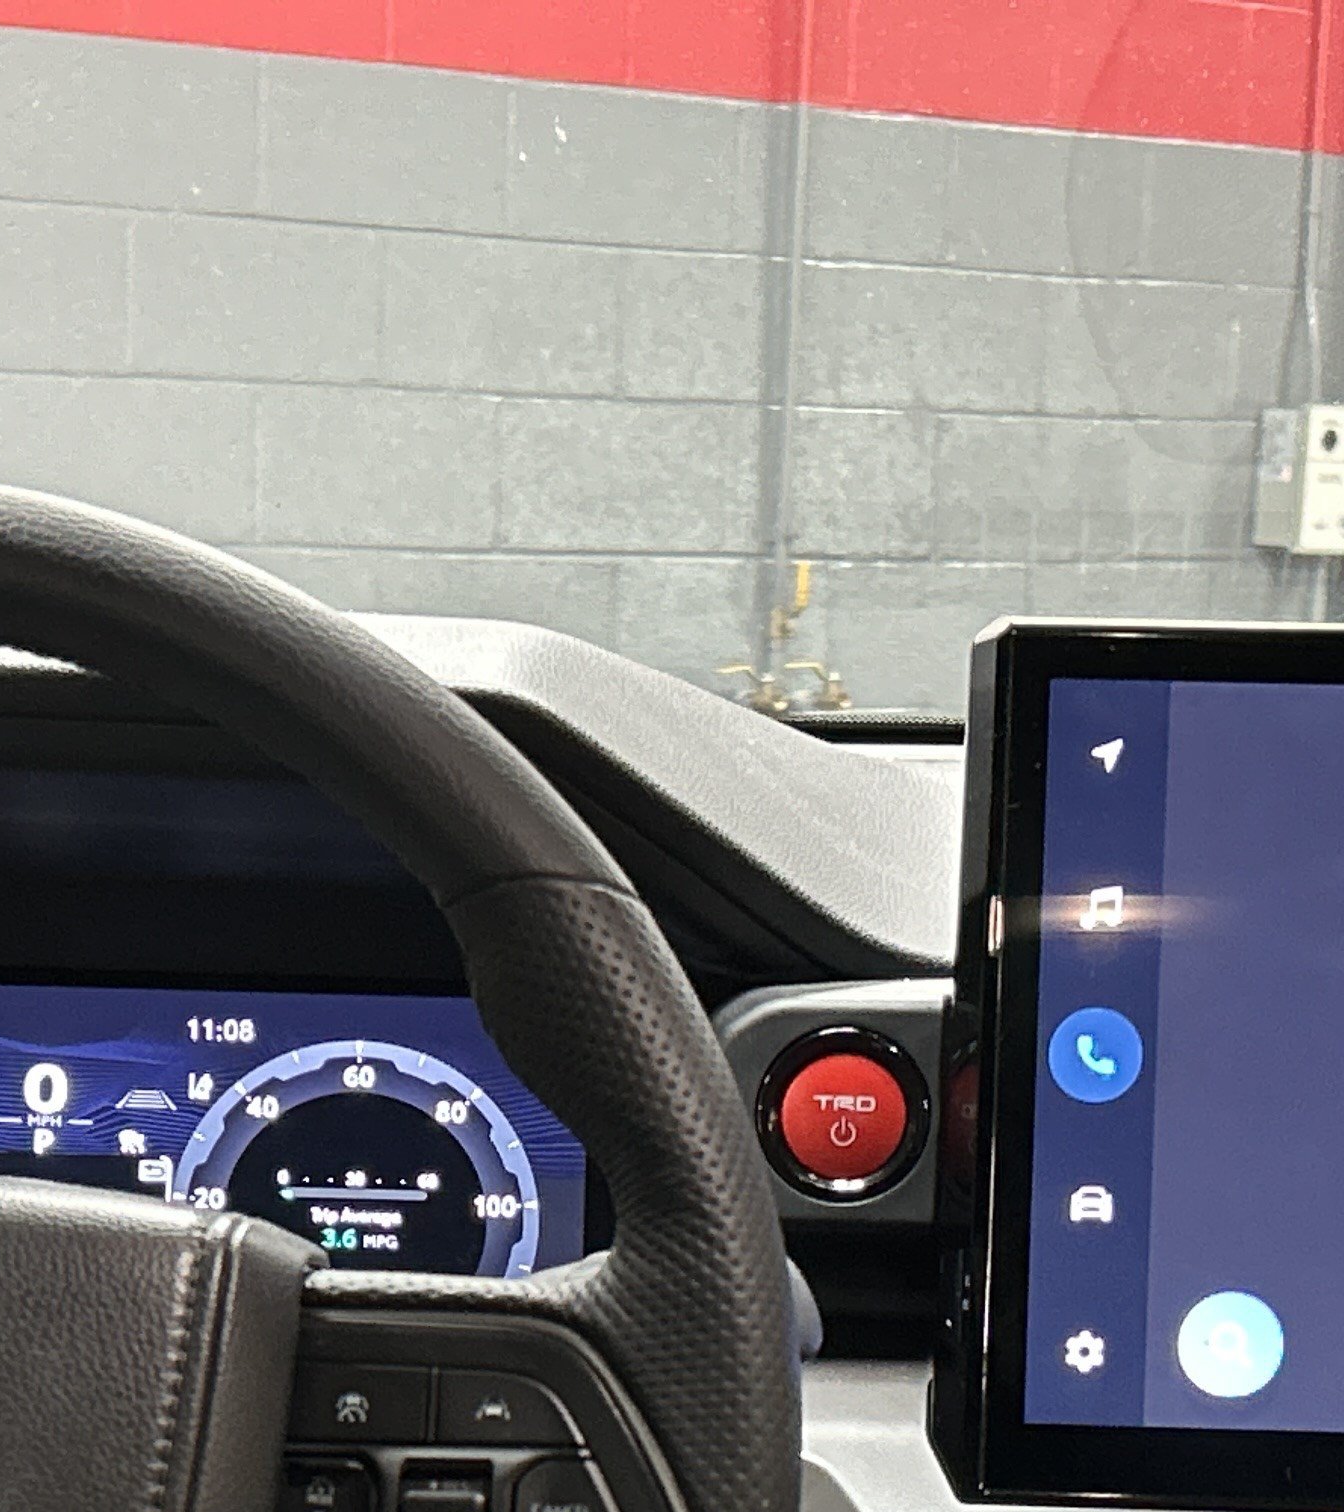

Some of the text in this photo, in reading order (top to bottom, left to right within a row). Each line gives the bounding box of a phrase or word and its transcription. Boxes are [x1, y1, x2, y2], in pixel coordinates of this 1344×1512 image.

[187, 1016, 254, 1042] 11:08
[24, 1062, 68, 1115] 0
[343, 1066, 375, 1089] 60
[247, 1098, 279, 1119] 40
[434, 1100, 467, 1124] 80
[812, 1094, 877, 1113] TRD
[33, 1128, 56, 1155] P
[194, 1188, 225, 1210] 20
[474, 1194, 516, 1218] 100
[320, 1228, 399, 1250] 3.6 MPG
